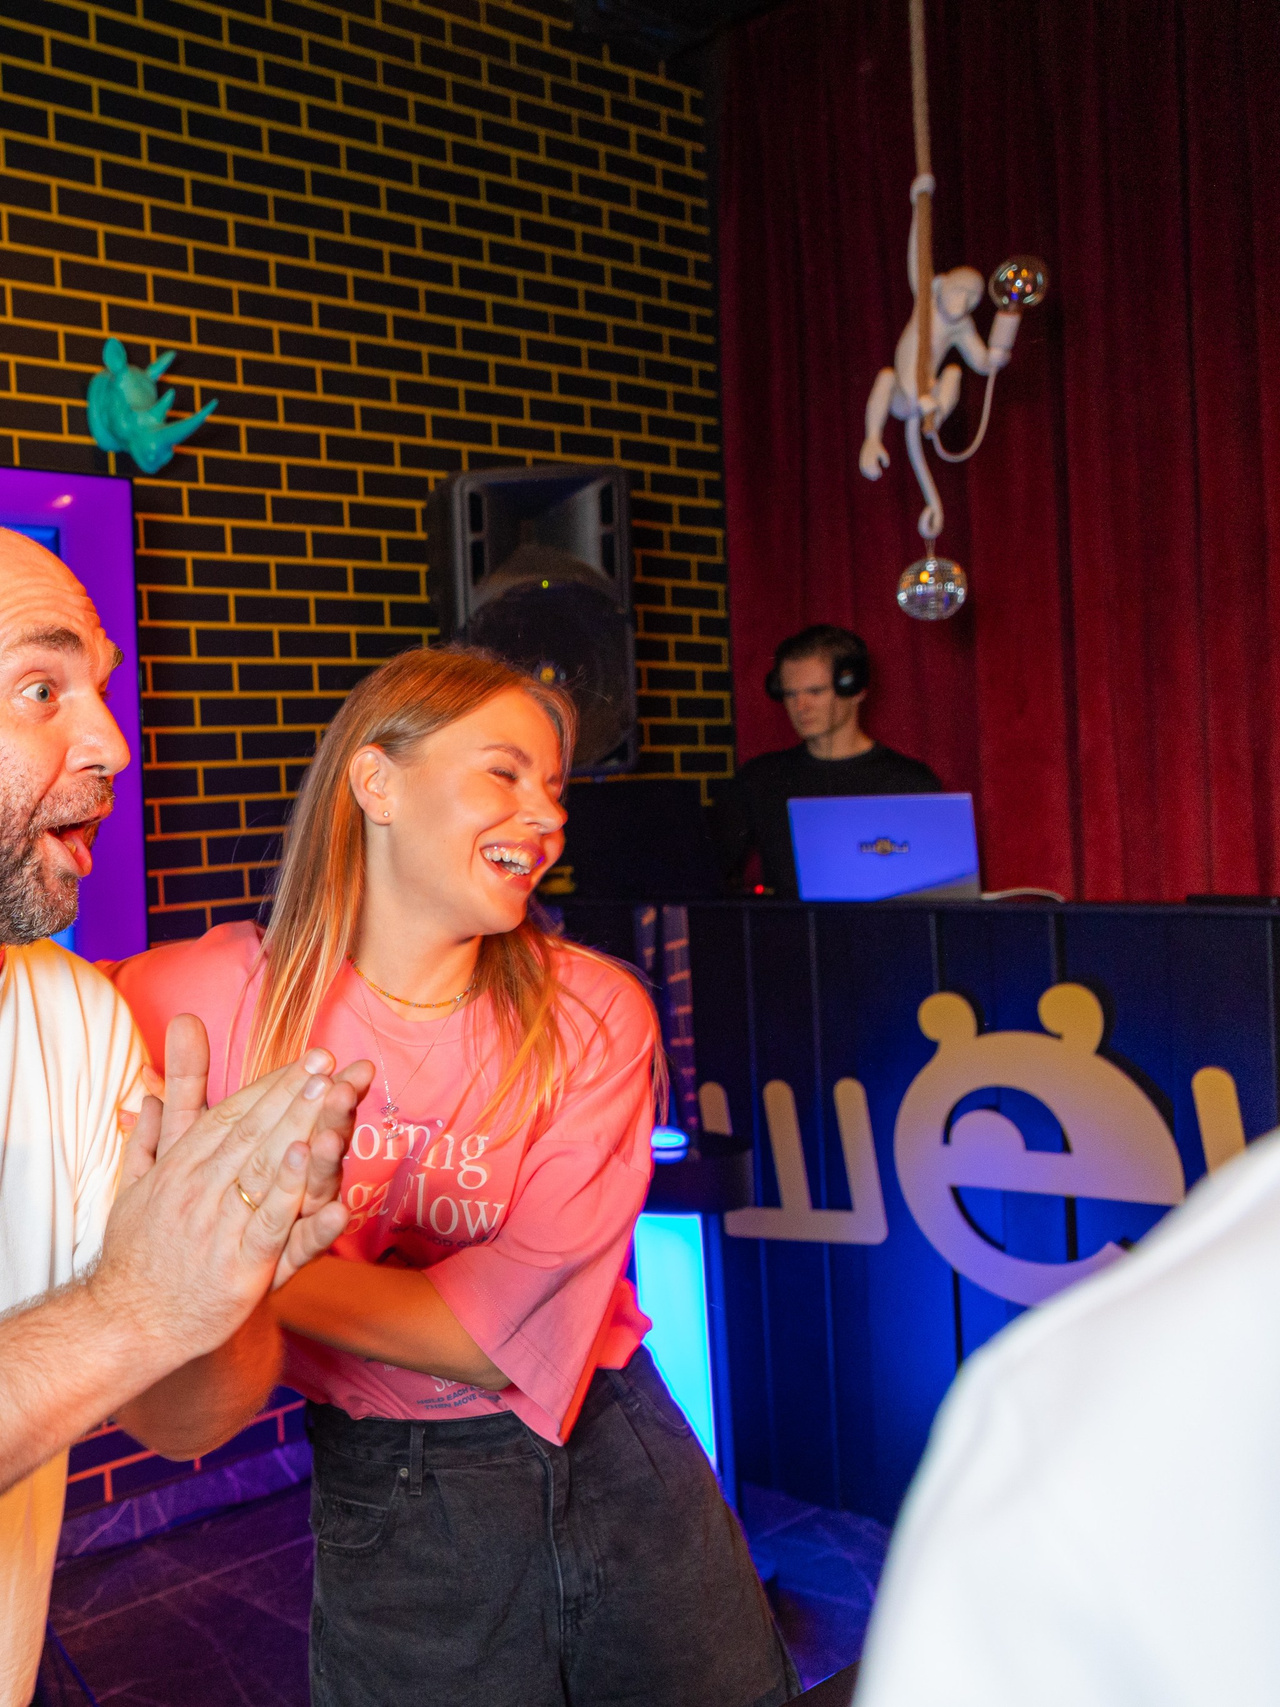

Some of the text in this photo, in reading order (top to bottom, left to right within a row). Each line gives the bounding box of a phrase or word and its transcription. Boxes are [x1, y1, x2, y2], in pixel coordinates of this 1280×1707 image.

[342, 1119, 490, 1191] orning
[446, 1386, 469, 1401] EACH
[453, 1393, 477, 1408] MOVE
